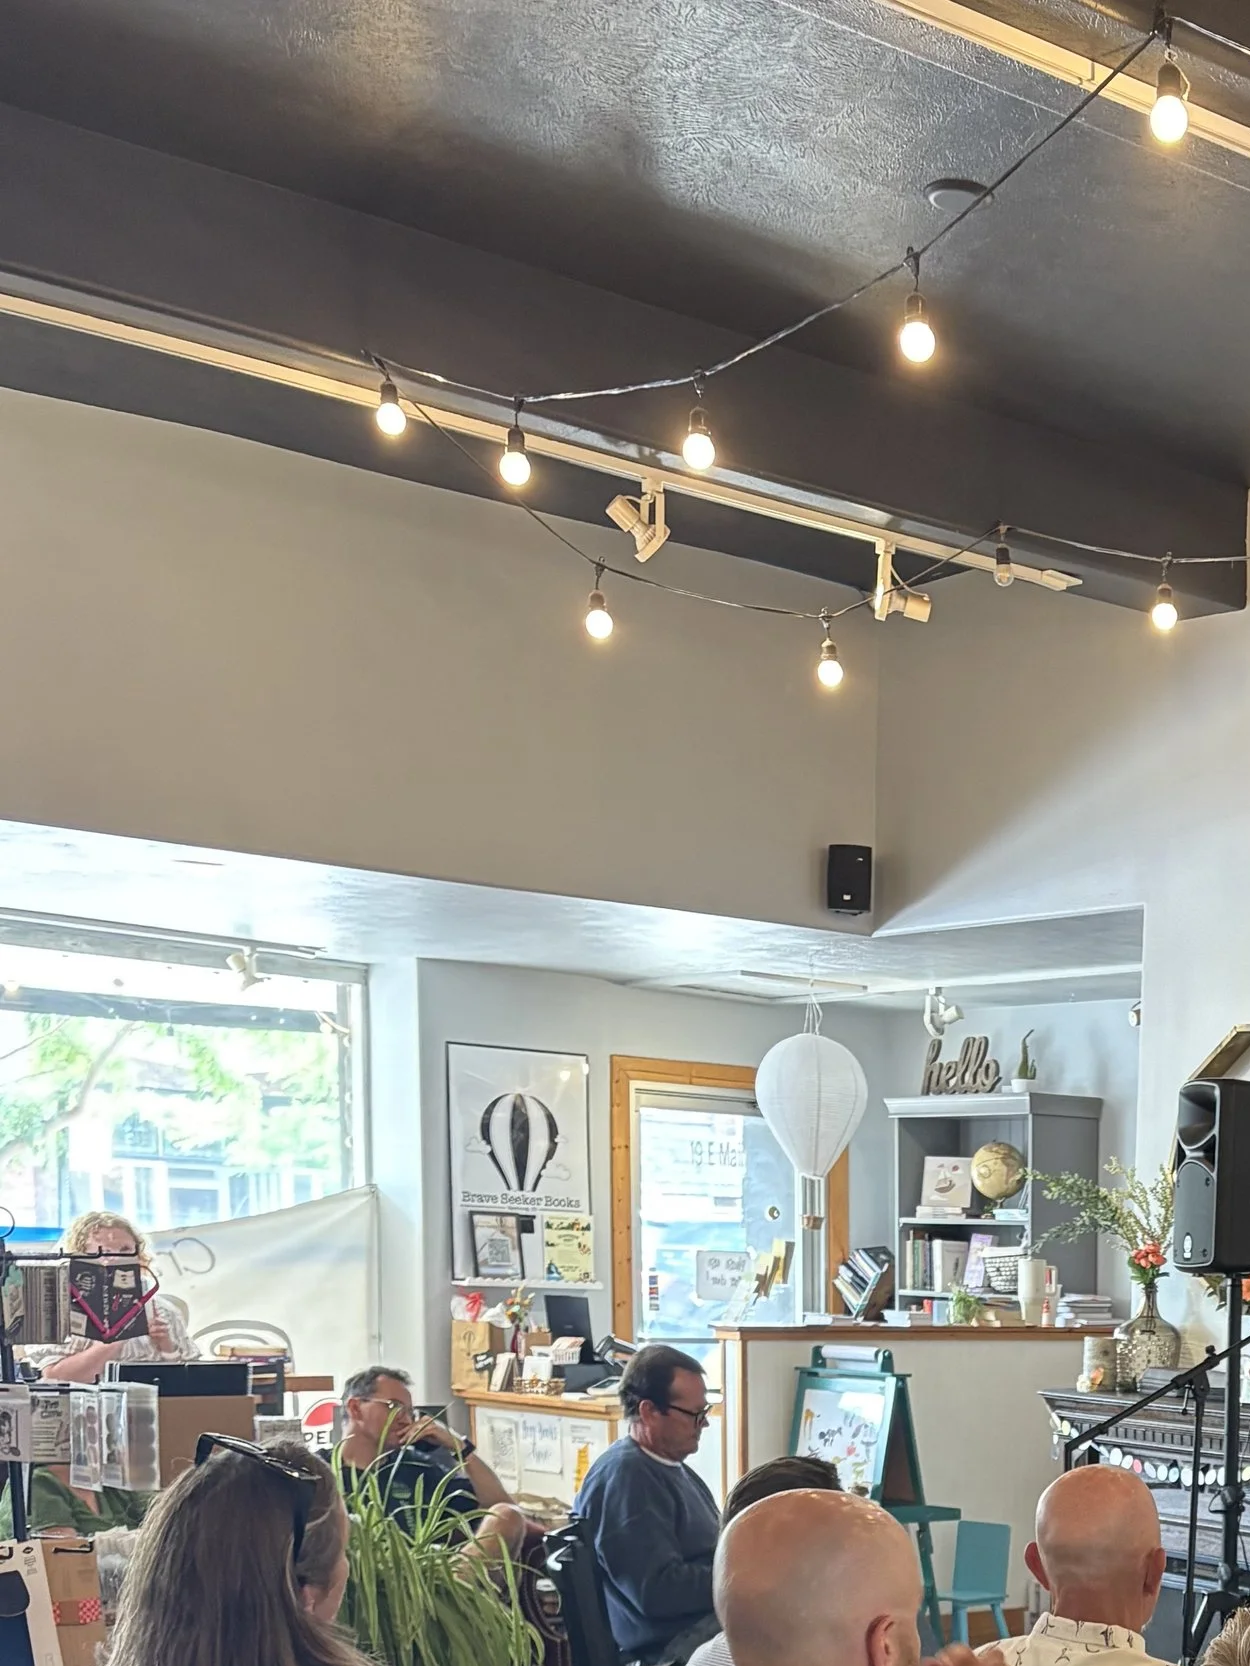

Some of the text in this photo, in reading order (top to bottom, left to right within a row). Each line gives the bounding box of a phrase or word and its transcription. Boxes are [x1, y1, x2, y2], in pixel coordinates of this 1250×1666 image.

[921, 1036, 1002, 1096] hello
[461, 1191, 580, 1208] Brave Seeker Books
